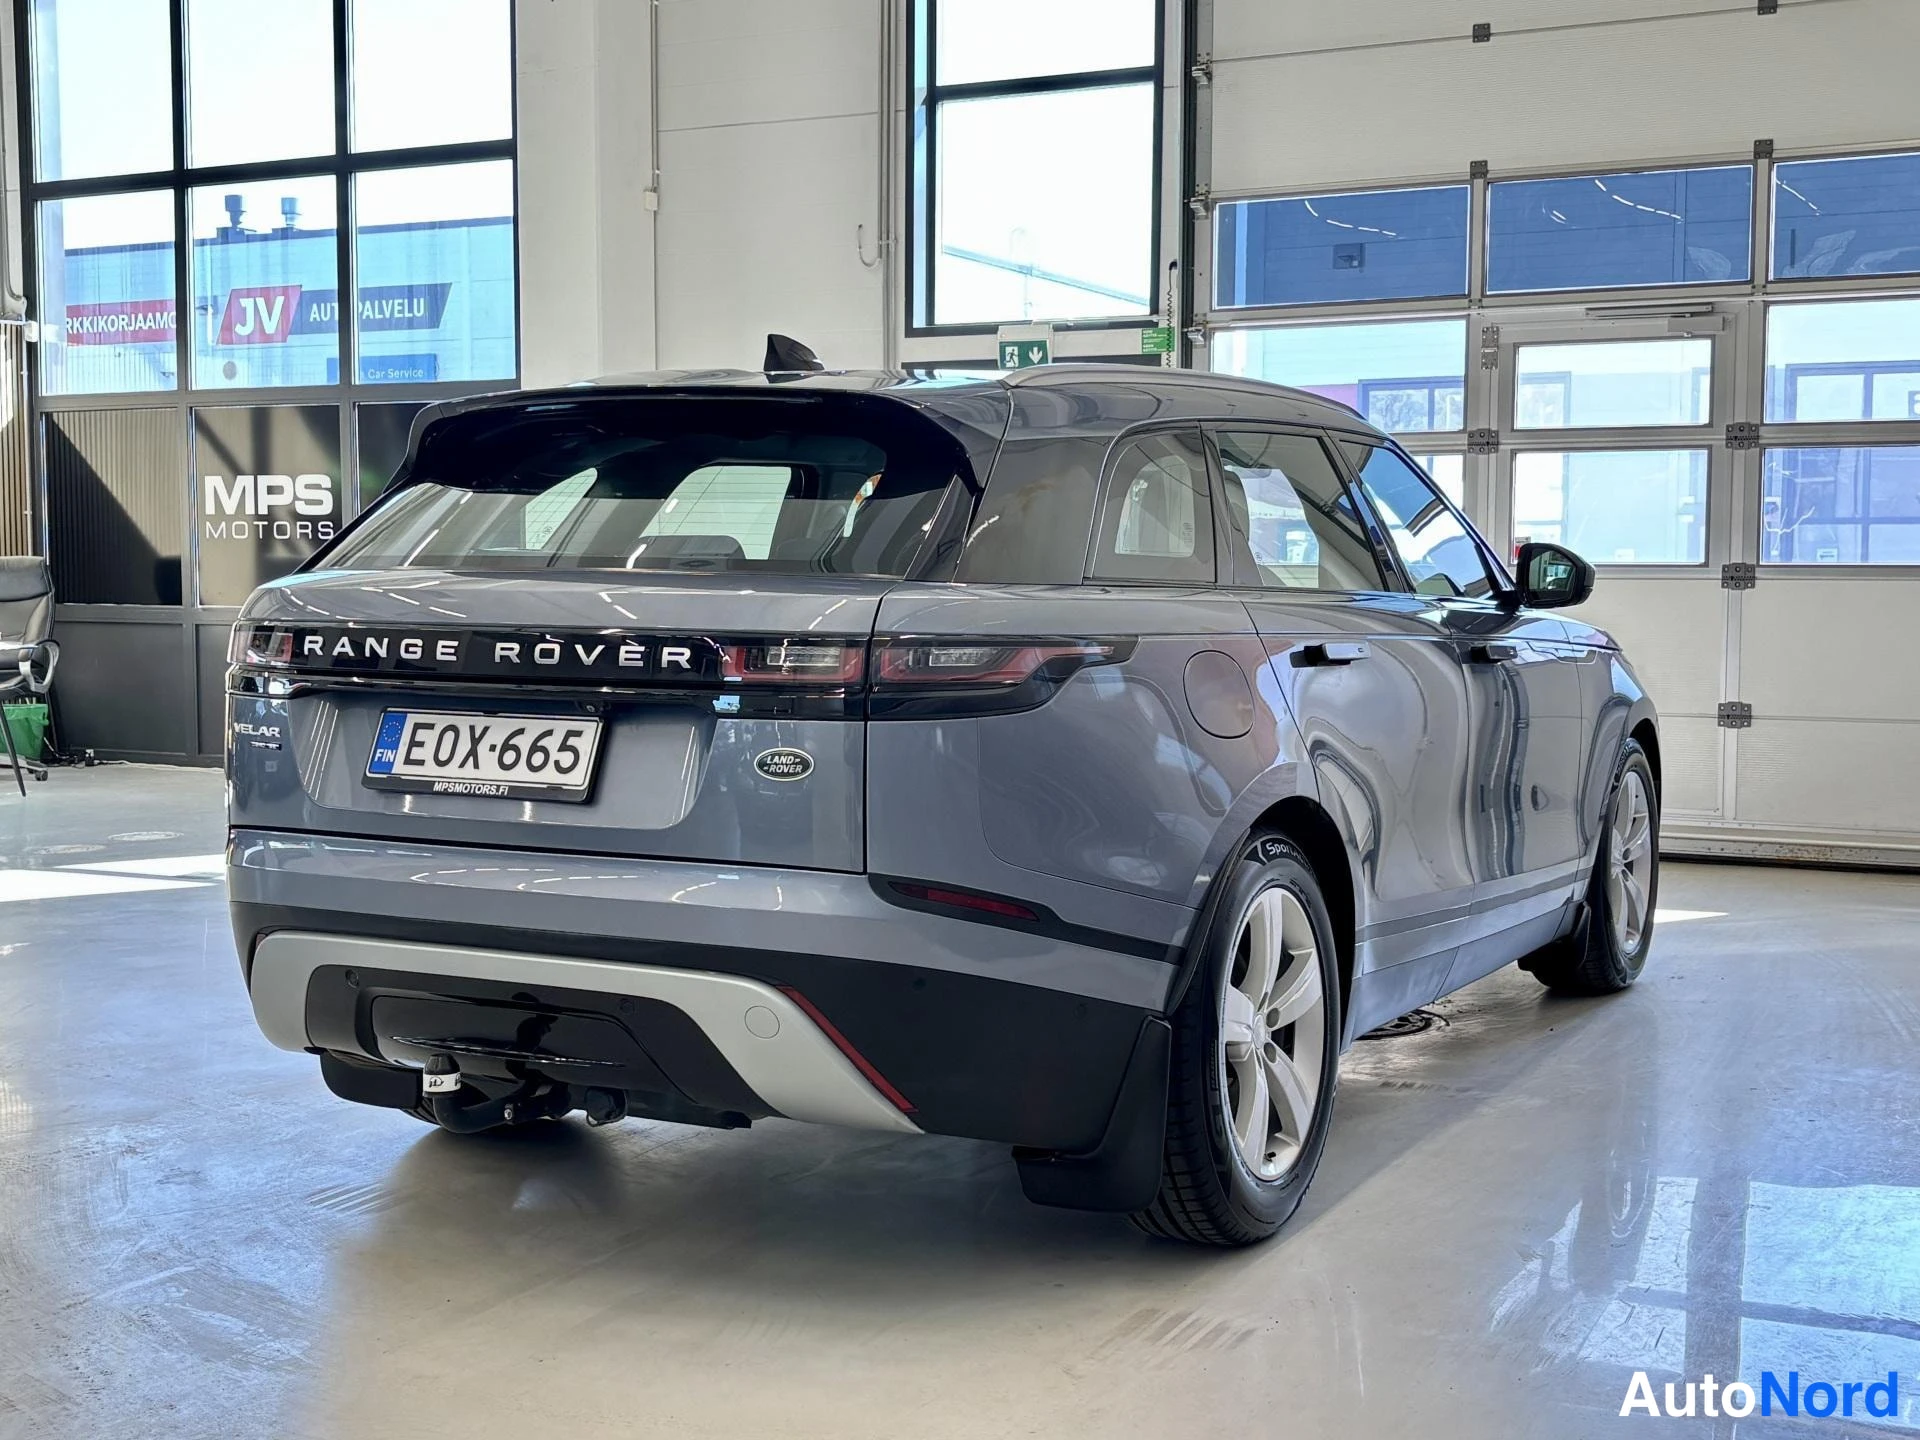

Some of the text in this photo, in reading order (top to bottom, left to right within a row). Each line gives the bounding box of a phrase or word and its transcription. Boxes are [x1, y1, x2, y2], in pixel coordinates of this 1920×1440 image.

[234, 296, 284, 336] JV
[309, 297, 424, 322] AUTALVELU
[368, 367, 424, 379] Car Service
[204, 474, 333, 515] MPS
[206, 521, 334, 539] MOTORS
[303, 635, 692, 669] RANGE ROVER
[233, 722, 281, 738] VELAR
[374, 748, 396, 763] FIN
[766, 755, 795, 764] LAND
[769, 764, 803, 773] ROVER
